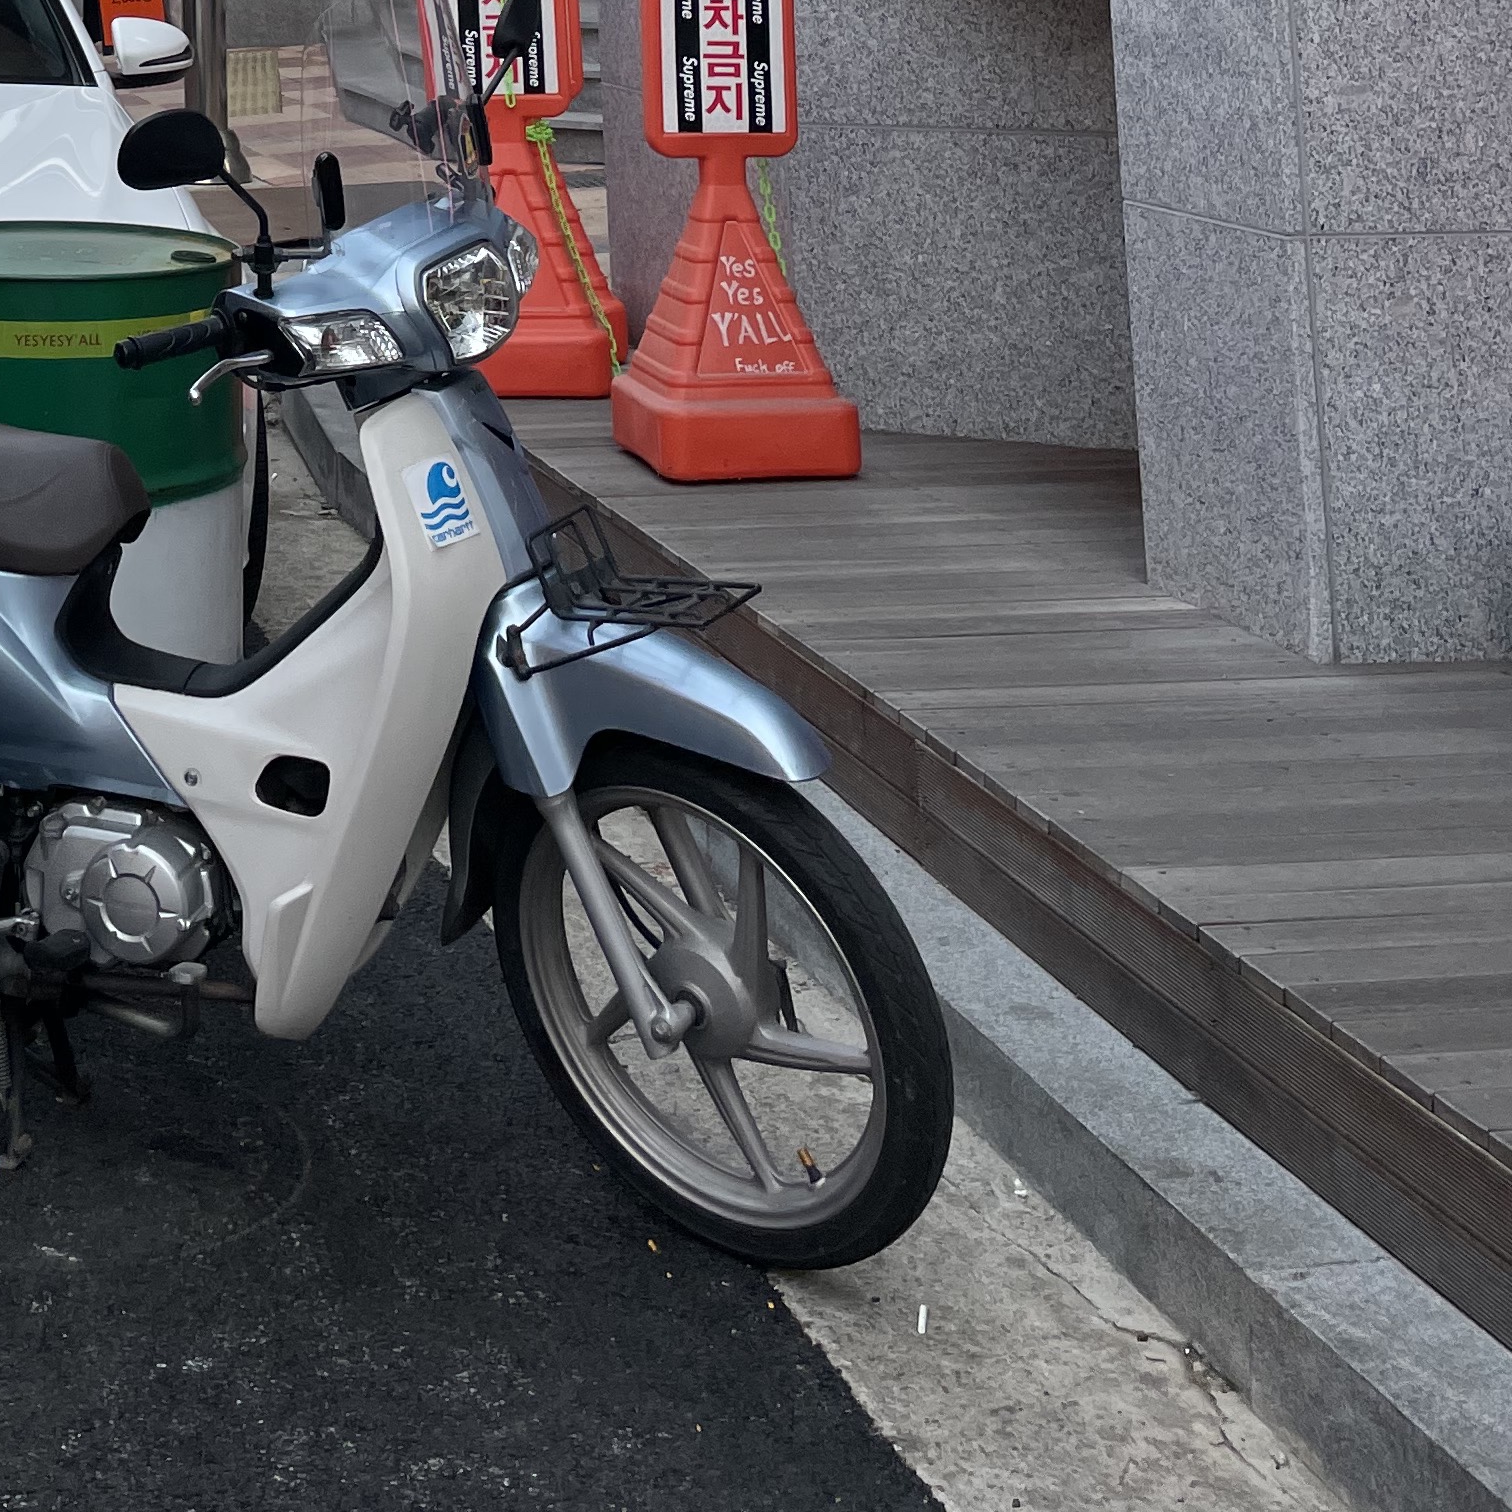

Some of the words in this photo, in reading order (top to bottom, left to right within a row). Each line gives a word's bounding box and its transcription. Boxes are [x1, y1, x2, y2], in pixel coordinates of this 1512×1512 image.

[678, 56, 698, 122] Supreme
[750, 61, 769, 127] Supreme
[719, 255, 756, 278] Yes
[720, 279, 764, 306] Yes
[710, 310, 793, 347] Y'ALL
